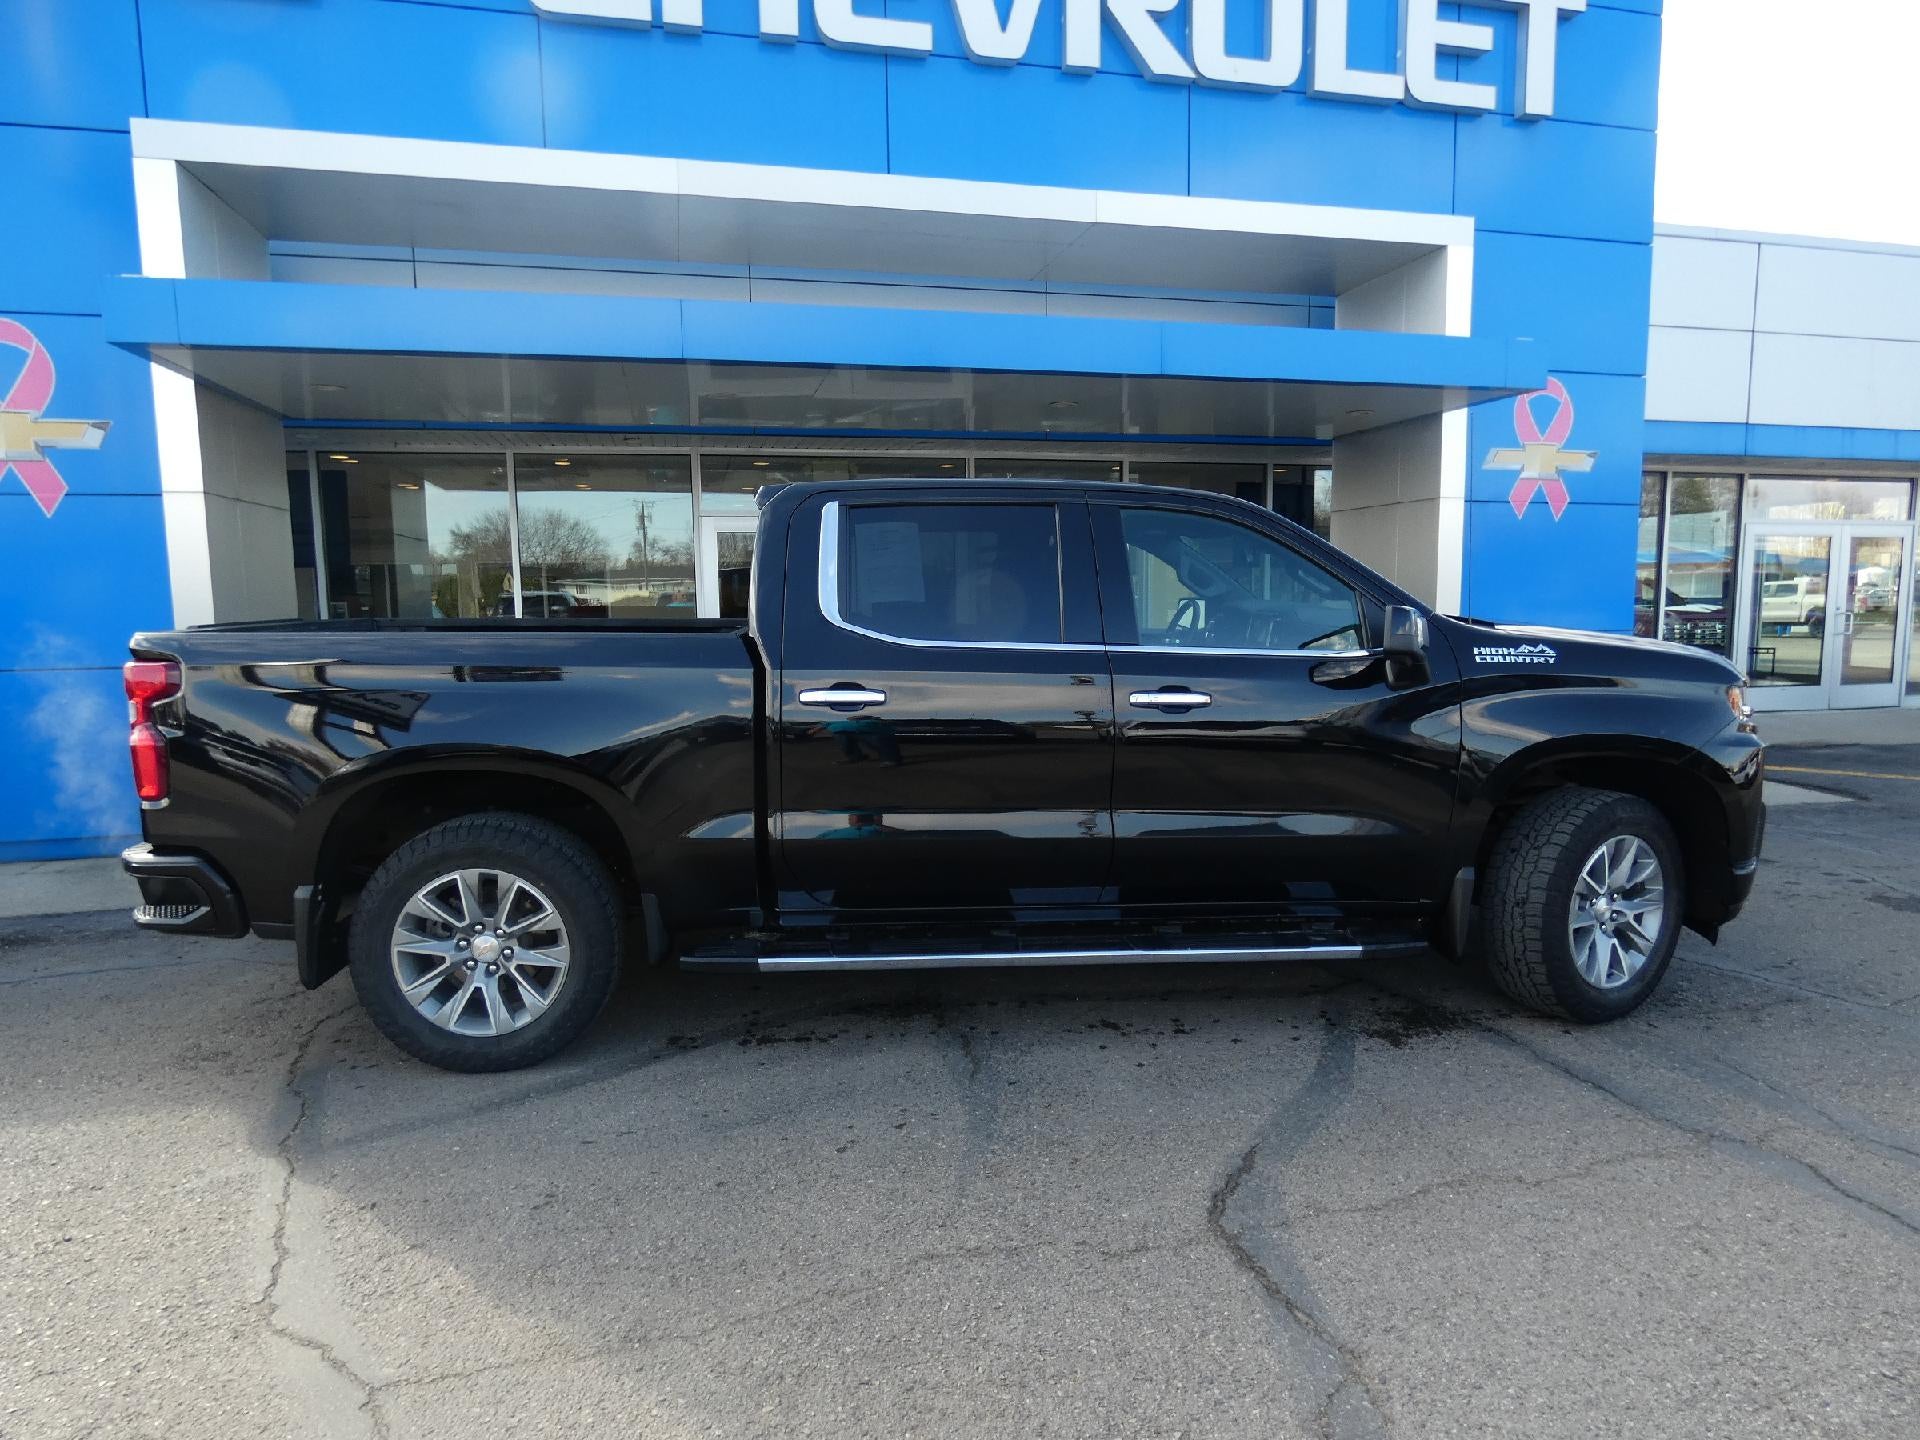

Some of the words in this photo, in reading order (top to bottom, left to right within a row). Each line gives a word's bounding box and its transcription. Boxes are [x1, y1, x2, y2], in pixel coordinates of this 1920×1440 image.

[529, 0, 1587, 121] ROLET
[1473, 646, 1515, 655] HIGH
[1474, 655, 1556, 664] COUNTRY
